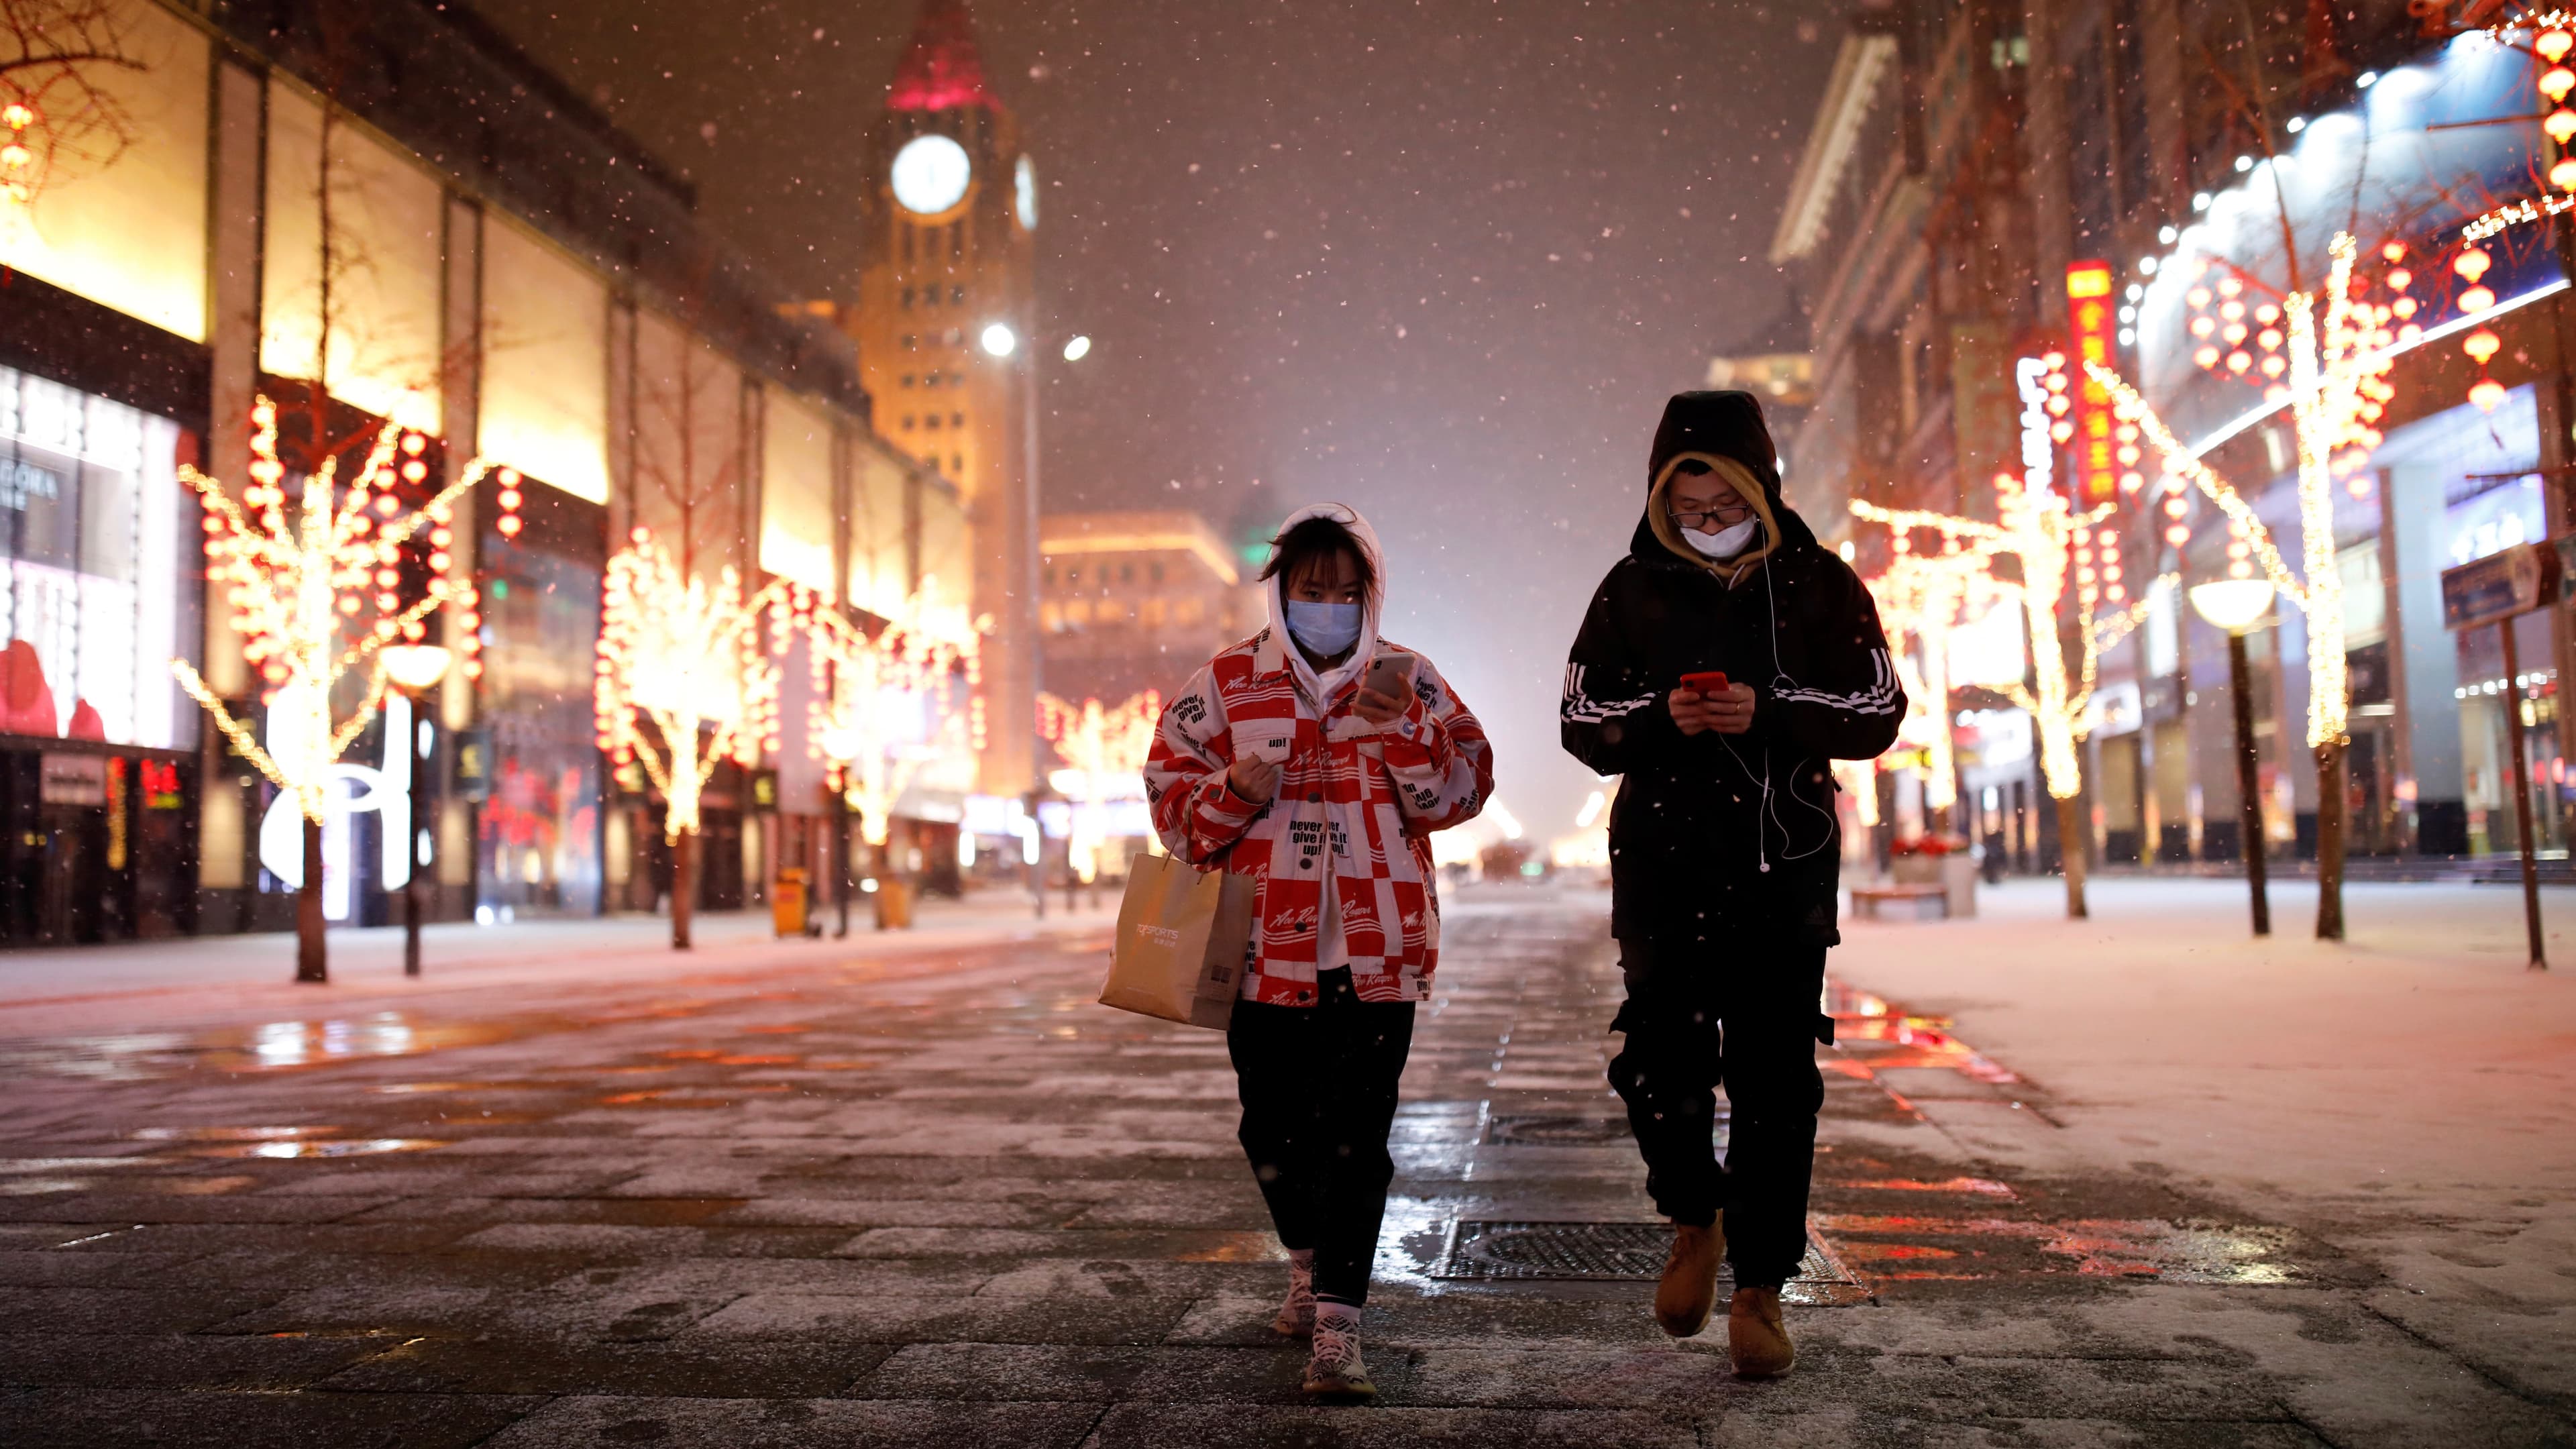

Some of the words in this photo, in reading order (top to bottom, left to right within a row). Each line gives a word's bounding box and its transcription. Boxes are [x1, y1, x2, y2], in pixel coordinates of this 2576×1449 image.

[1172, 694, 1198, 714] never
[1178, 704, 1199, 722] give
[1191, 707, 1207, 724] up!
[1269, 738, 1287, 748] up!
[1290, 820, 1322, 833] never
[1293, 831, 1317, 844] give
[1339, 832, 1348, 844] it
[1303, 845, 1322, 857] up!
